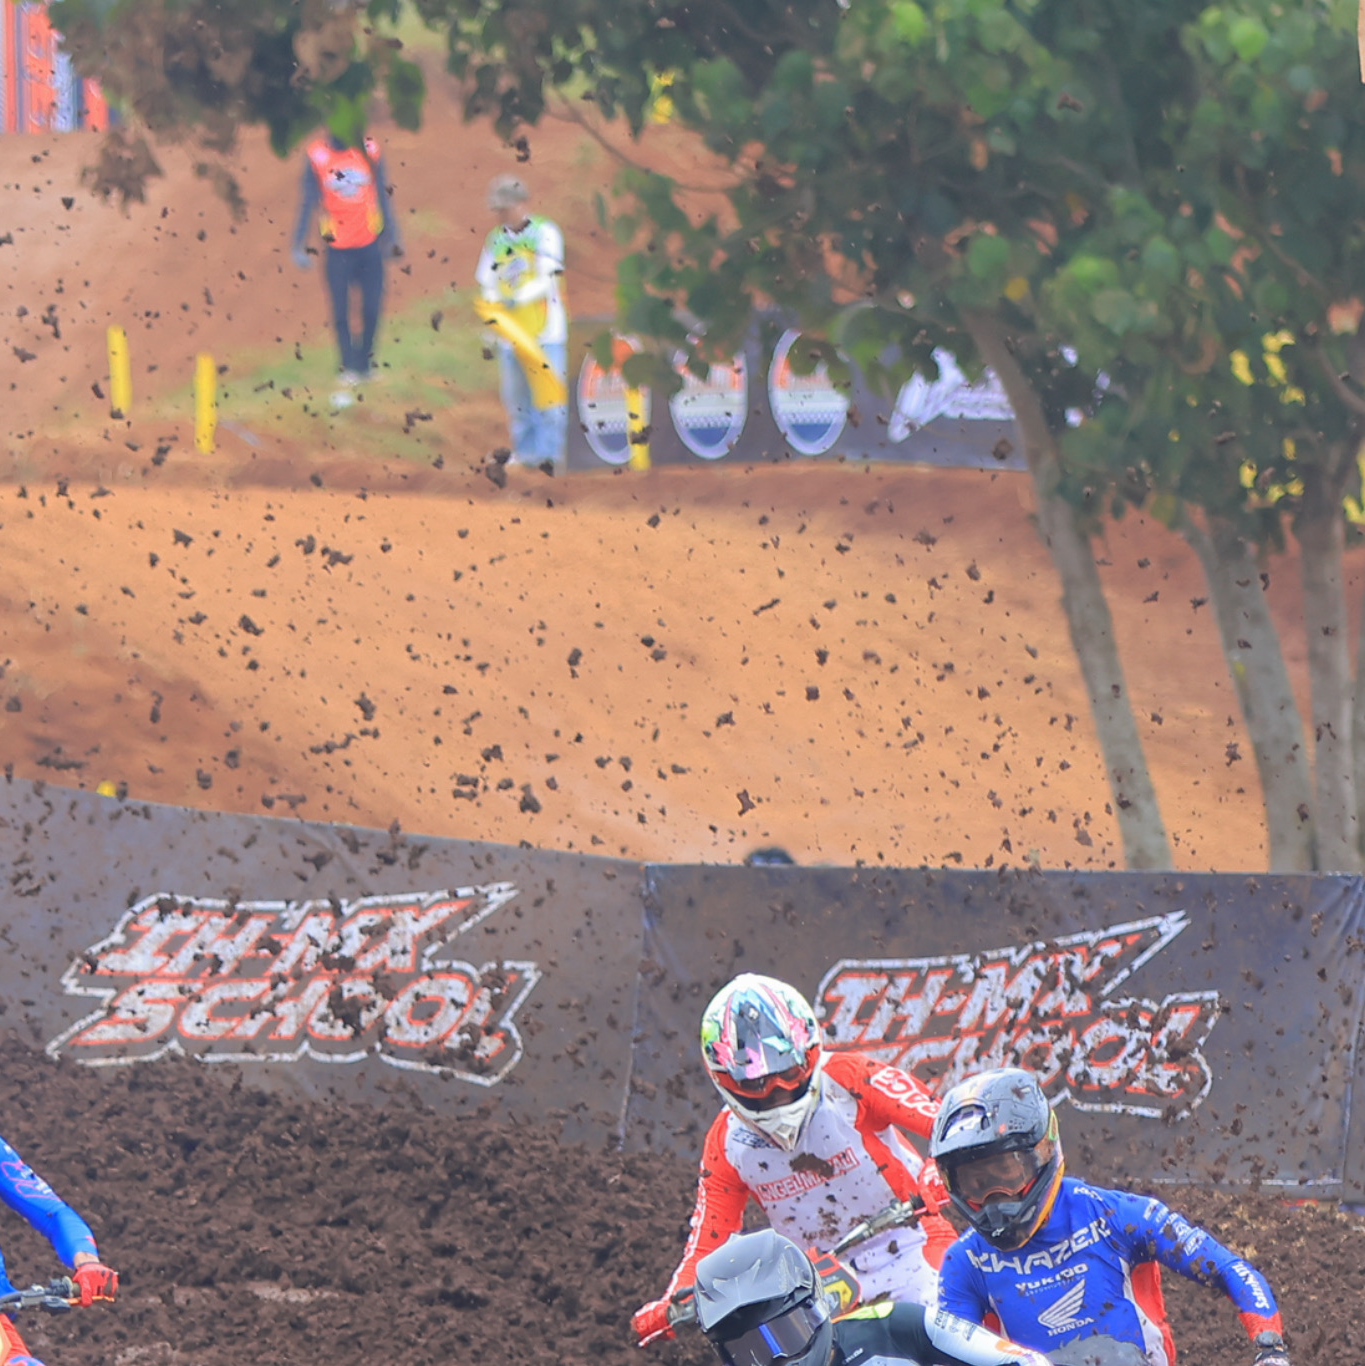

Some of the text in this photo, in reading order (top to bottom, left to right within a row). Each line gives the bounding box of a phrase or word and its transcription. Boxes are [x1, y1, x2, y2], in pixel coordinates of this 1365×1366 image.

[965, 1216, 1113, 1276] KWAZER
[1014, 1262, 1090, 1293] YUKIDO
[1047, 1316, 1096, 1337] HONDA
